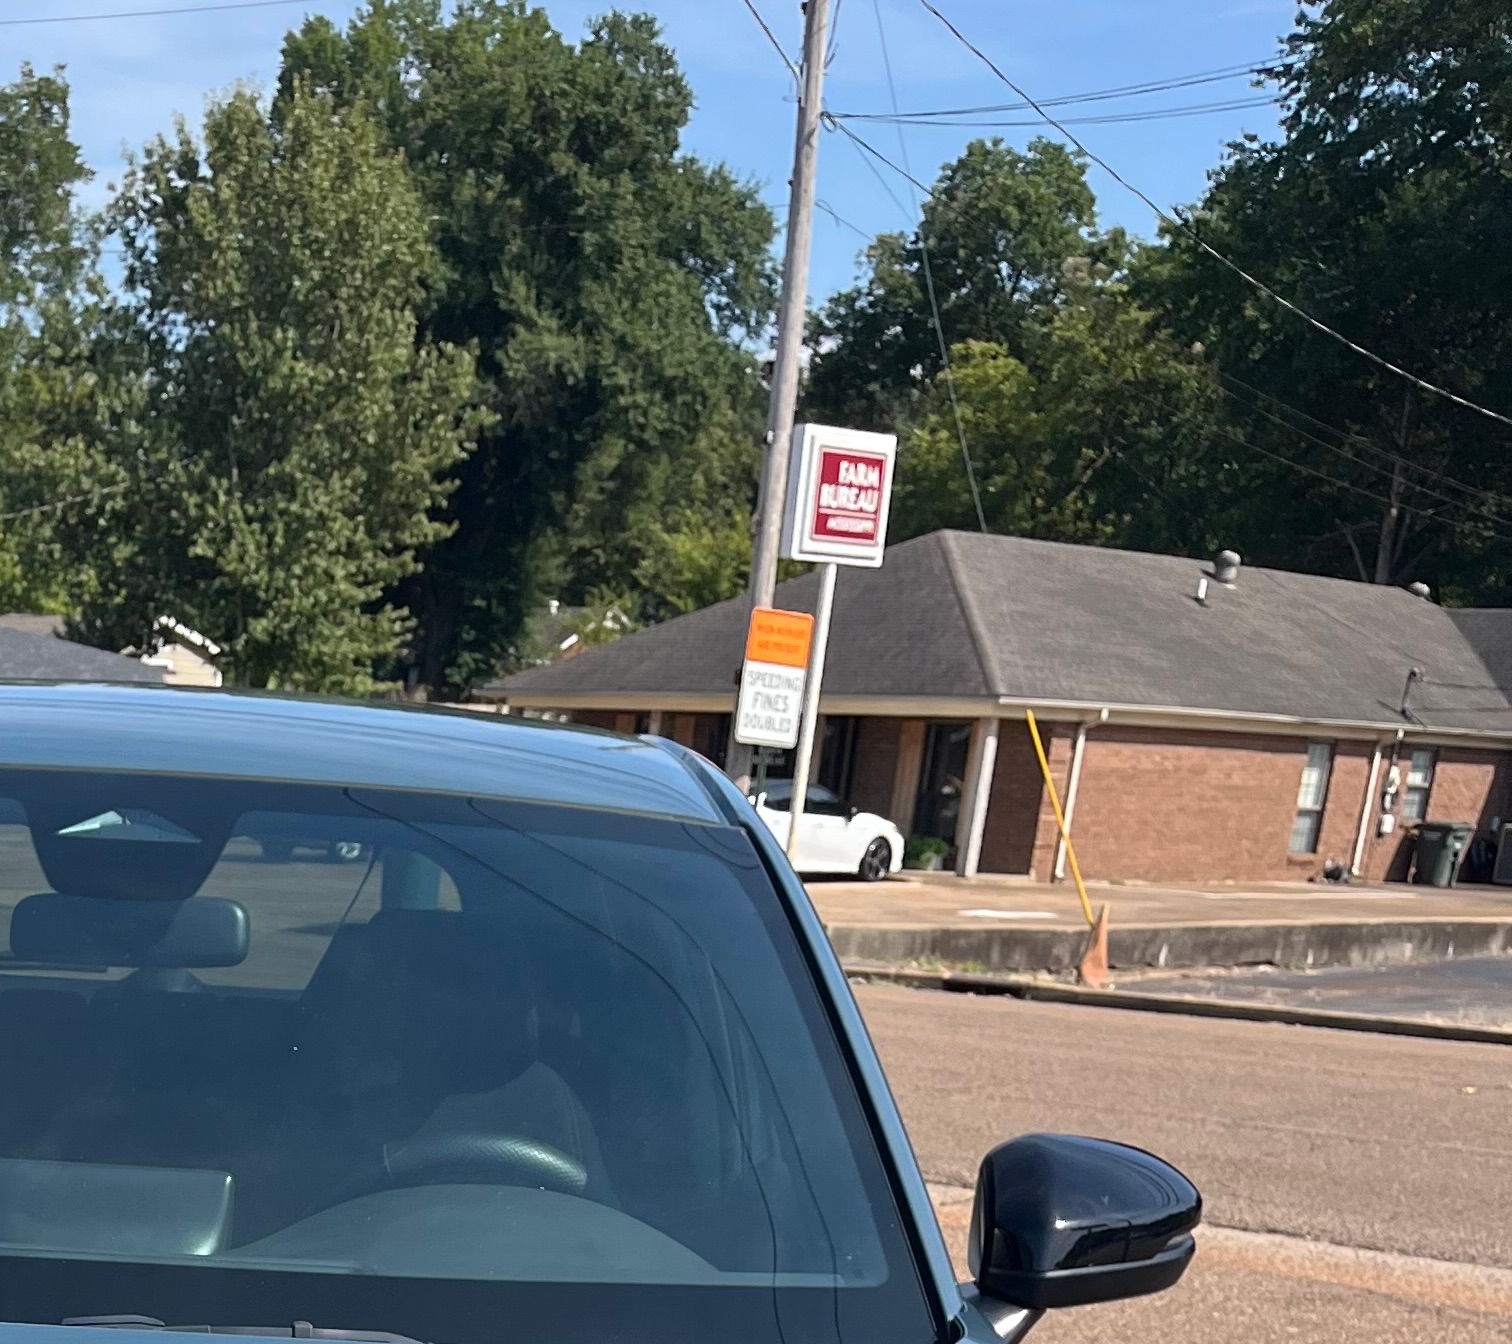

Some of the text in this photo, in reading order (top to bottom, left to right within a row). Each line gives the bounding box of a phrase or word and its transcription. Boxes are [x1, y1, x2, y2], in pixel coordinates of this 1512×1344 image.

[839, 460, 880, 488] FARM
[819, 483, 879, 513] BUREAU
[751, 691, 790, 713] FINES
